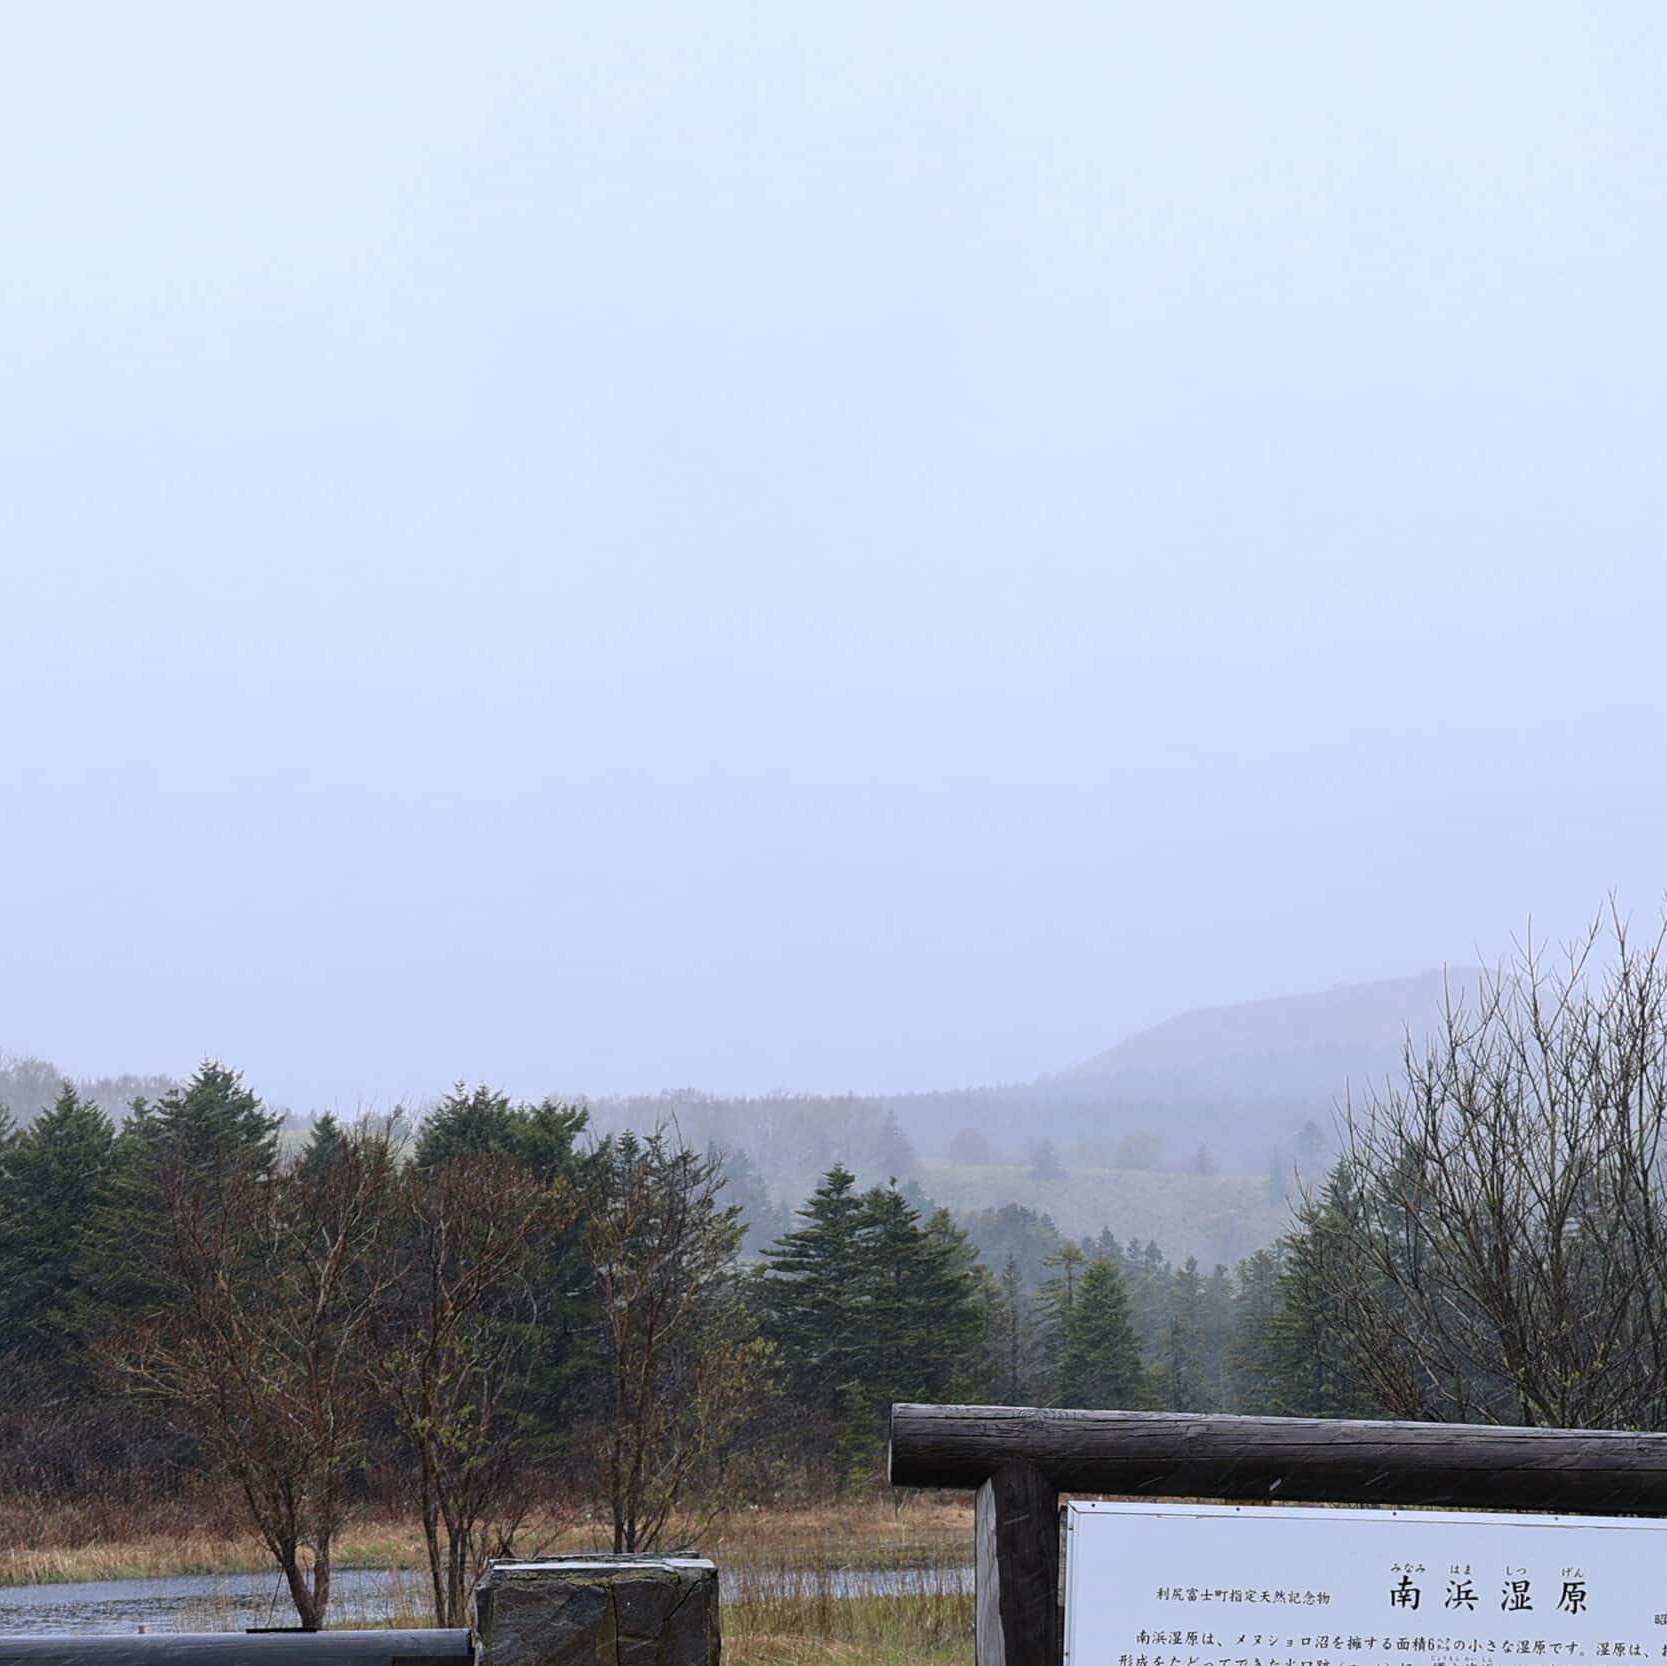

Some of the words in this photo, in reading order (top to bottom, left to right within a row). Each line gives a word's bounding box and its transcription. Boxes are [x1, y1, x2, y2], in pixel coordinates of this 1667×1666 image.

[1390, 1562, 1426, 1574] みなみ
[1450, 1564, 1471, 1575] はま
[1506, 1565, 1527, 1576] しつ
[1561, 1567, 1584, 1578] げん
[1155, 1586, 1331, 1606] 利尻富士町指定天然記念物
[1389, 1575, 1587, 1615] 南浜湿原
